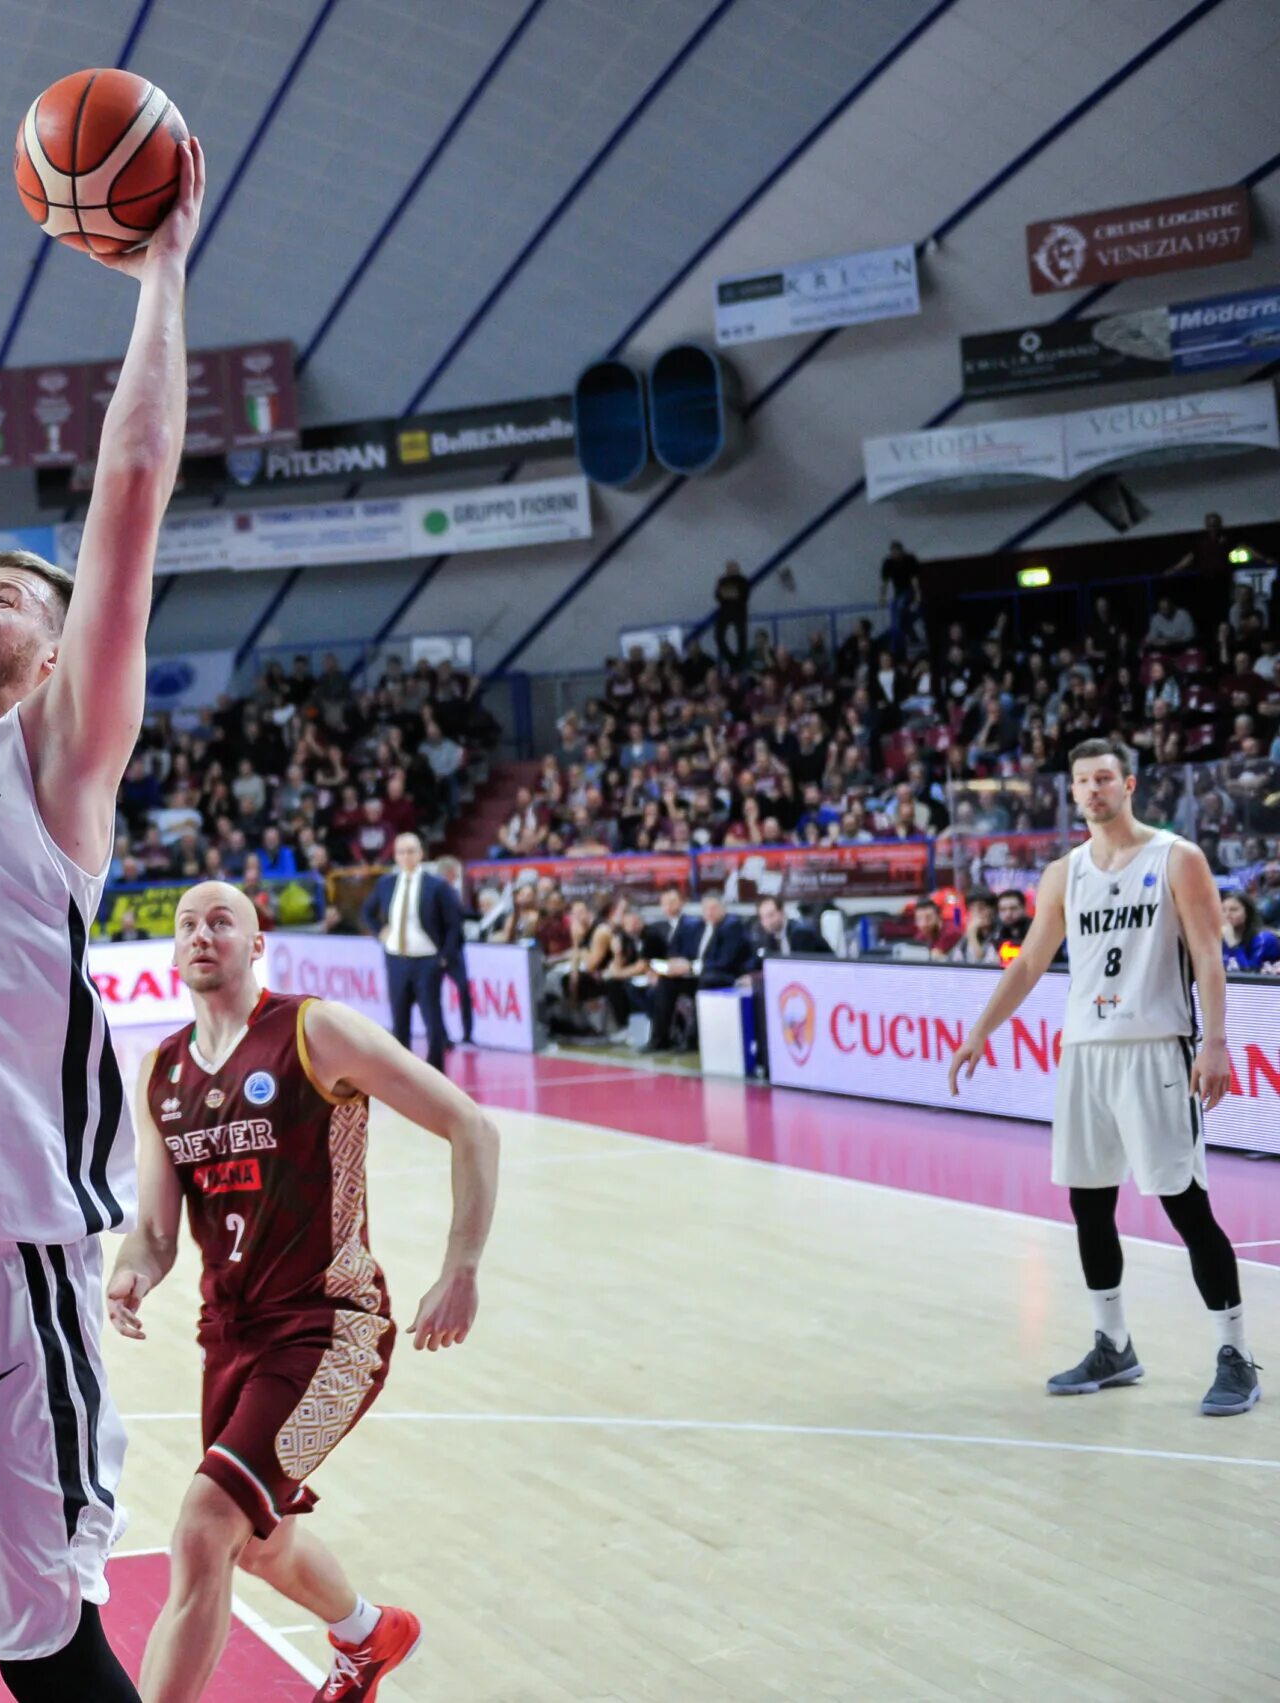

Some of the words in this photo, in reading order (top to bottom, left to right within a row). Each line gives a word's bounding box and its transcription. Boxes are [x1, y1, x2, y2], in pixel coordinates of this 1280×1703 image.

[1094, 219, 1152, 240] CRUISE
[1157, 202, 1240, 227] LOGISTIC
[1097, 236, 1193, 266] VENEZIA
[1197, 226, 1242, 250] 1937
[453, 499, 516, 525] GRUPPO
[521, 492, 579, 516] FIORINI
[1080, 904, 1158, 936] NIZHNY
[299, 960, 380, 1001] CUCINA
[1104, 947, 1123, 977] 8
[165, 1119, 277, 1164] REYER
[226, 1213, 246, 1263] 2
